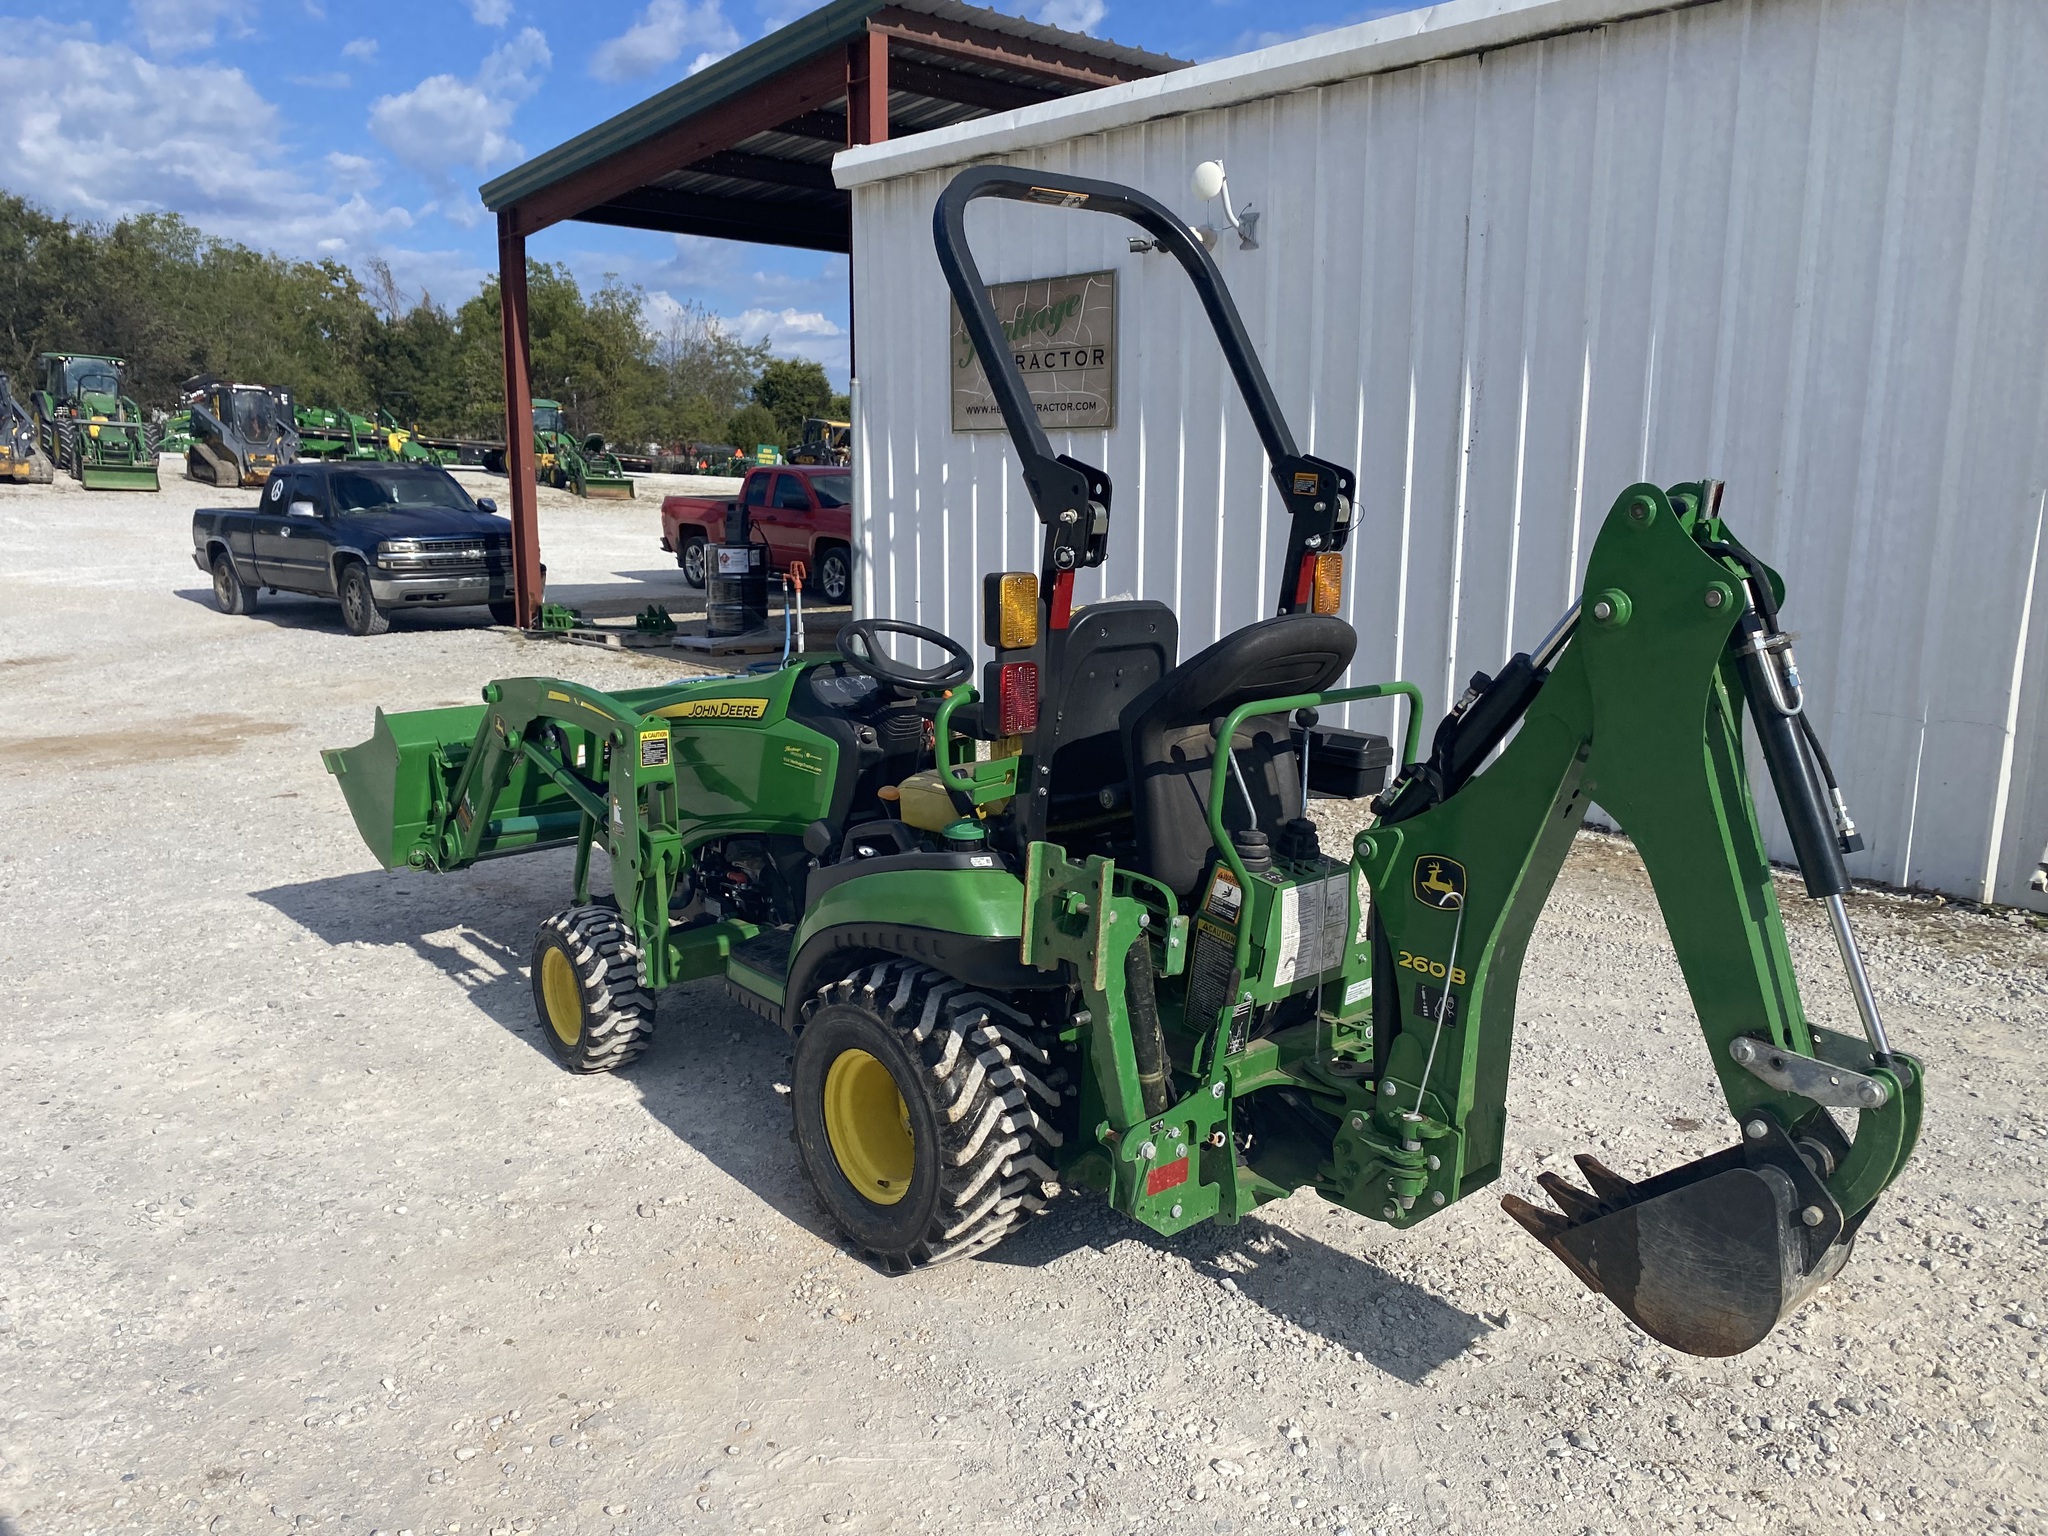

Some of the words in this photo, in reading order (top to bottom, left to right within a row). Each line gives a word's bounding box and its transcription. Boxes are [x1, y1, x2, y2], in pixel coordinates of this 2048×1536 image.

[1015, 349, 1105, 370] RACTOR
[965, 401, 1097, 415] WWW.HERACTOR.COM
[688, 702, 719, 716] JOHN
[720, 702, 760, 717] DEERE
[648, 731, 667, 739] CAUTION
[1208, 925, 1236, 944] CAUTION
[1398, 950, 1467, 986] 260B
